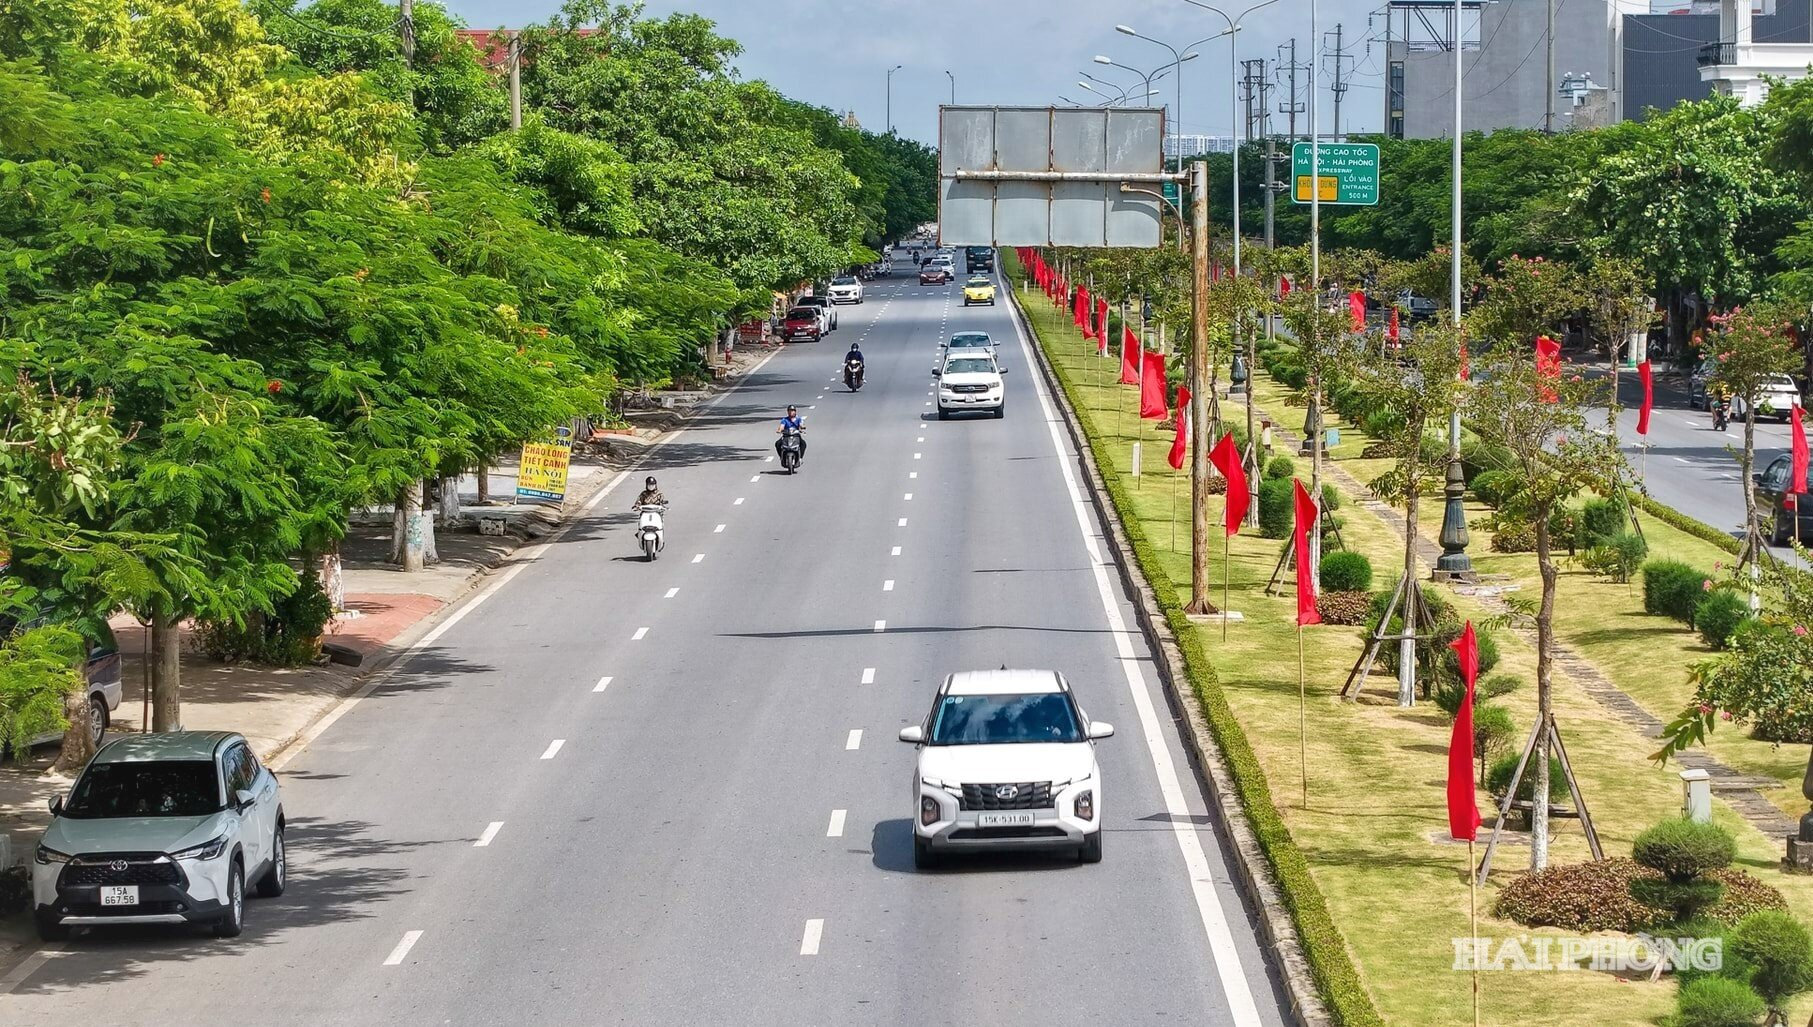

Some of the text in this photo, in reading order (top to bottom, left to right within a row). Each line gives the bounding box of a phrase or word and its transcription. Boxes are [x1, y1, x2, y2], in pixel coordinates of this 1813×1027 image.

[1352, 148, 1368, 156] TỐC
[1297, 157, 1309, 165] HÀ
[1332, 157, 1346, 166] HẢI
[1348, 158, 1374, 166] PHÒNG
[1343, 174, 1373, 183] LỐI VÀO
[543, 459, 567, 469] CANH
[112, 886, 128, 896] 15A
